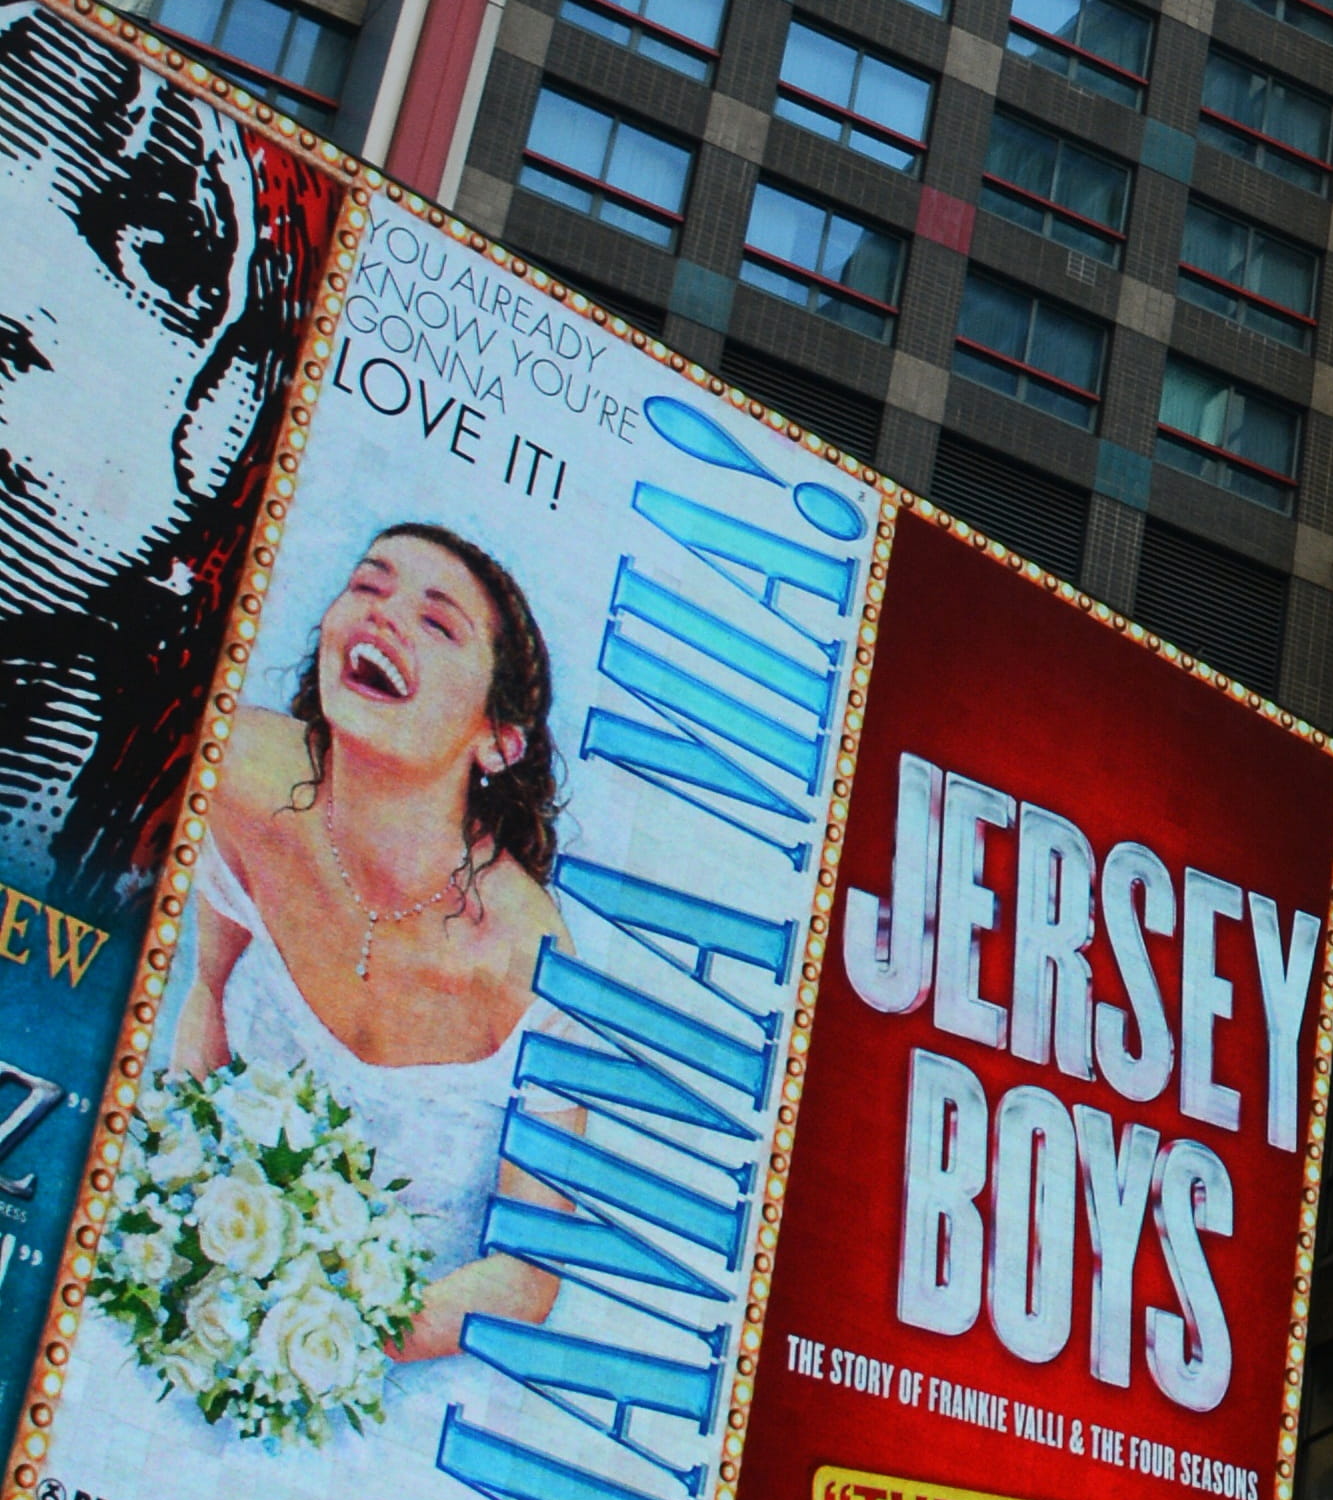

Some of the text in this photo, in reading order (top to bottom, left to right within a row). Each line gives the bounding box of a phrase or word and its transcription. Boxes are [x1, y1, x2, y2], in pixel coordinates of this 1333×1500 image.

[345, 295, 506, 414] GONNA
[356, 252, 639, 445] KNOW YOU'RE
[367, 207, 607, 373] YOU ALREADY
[332, 337, 566, 511] LOVE IT!
[582, 396, 868, 873] MIA!
[843, 751, 1320, 1154] JERSEY
[897, 1048, 1234, 1412] BOYS
[787, 1334, 824, 1379] THE
[830, 1349, 892, 1399] STORY
[899, 1368, 924, 1407] OF
[928, 1378, 1007, 1433] FRANKIE
[1014, 1404, 1064, 1449] VALLI
[1069, 1419, 1085, 1455] &
[1090, 1425, 1124, 1466] THE
[1129, 1436, 1175, 1481] FOUR
